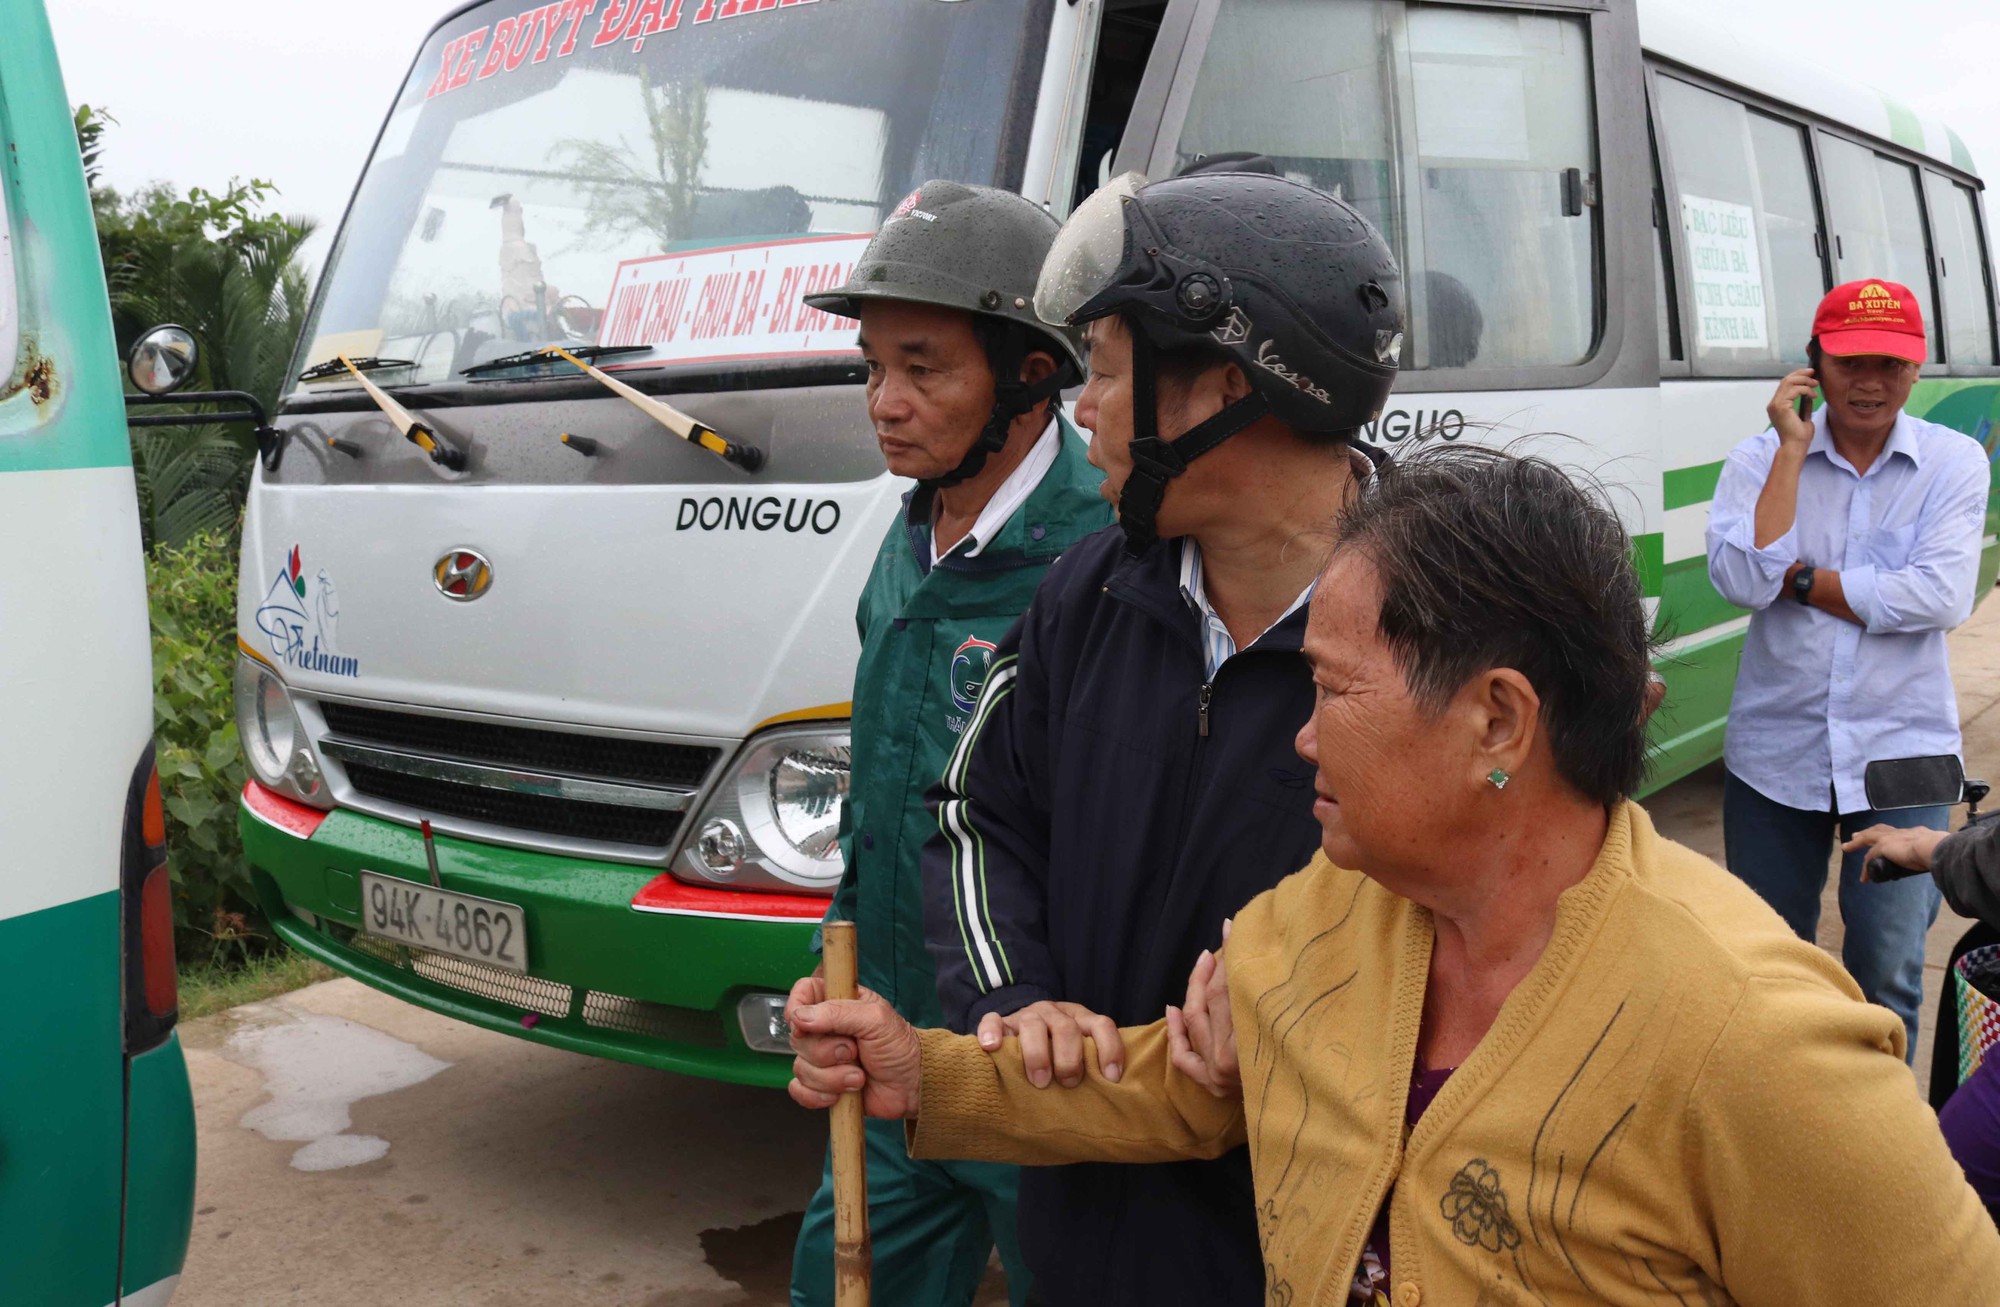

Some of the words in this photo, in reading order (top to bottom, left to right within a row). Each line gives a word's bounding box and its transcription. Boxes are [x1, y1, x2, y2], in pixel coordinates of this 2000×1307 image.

[425, 27, 490, 100] XE
[591, 0, 683, 53] ĐẠI
[911, 209, 938, 223] VICTORY
[641, 261, 692, 343] CHÂU
[768, 264, 805, 334] BX
[1253, 339, 1332, 405] Vesa
[676, 496, 841, 535] DONGUO
[270, 617, 359, 678] Vietnam
